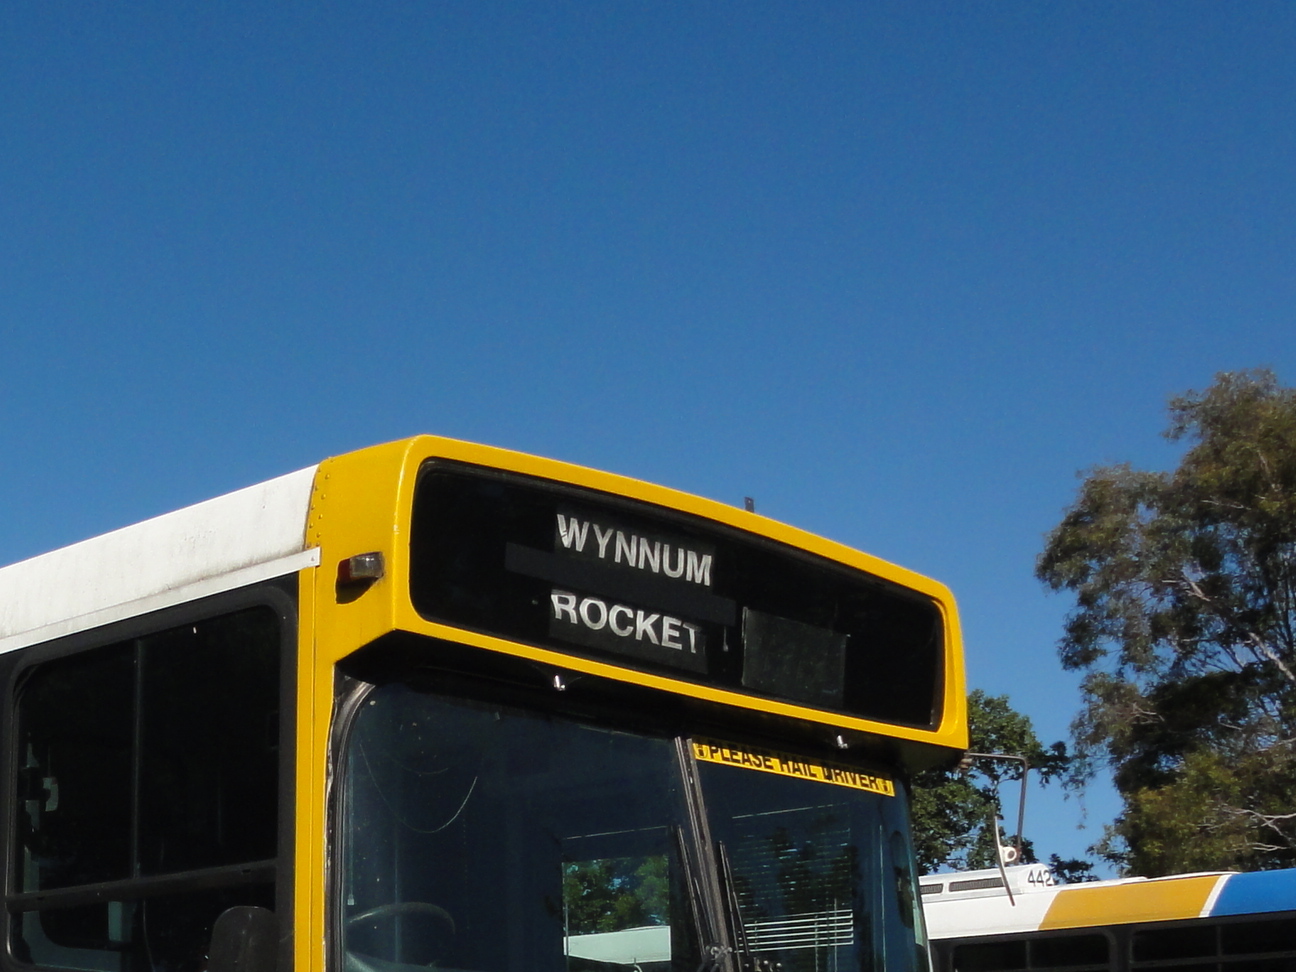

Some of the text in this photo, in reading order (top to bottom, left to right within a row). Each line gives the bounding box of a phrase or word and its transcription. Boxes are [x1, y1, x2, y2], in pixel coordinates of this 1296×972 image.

[556, 514, 712, 586] WYNNUM
[551, 589, 702, 654] ROCKET
[708, 741, 879, 790] PLEASE HAIL DRIVER
[1027, 869, 1054, 887] 442
